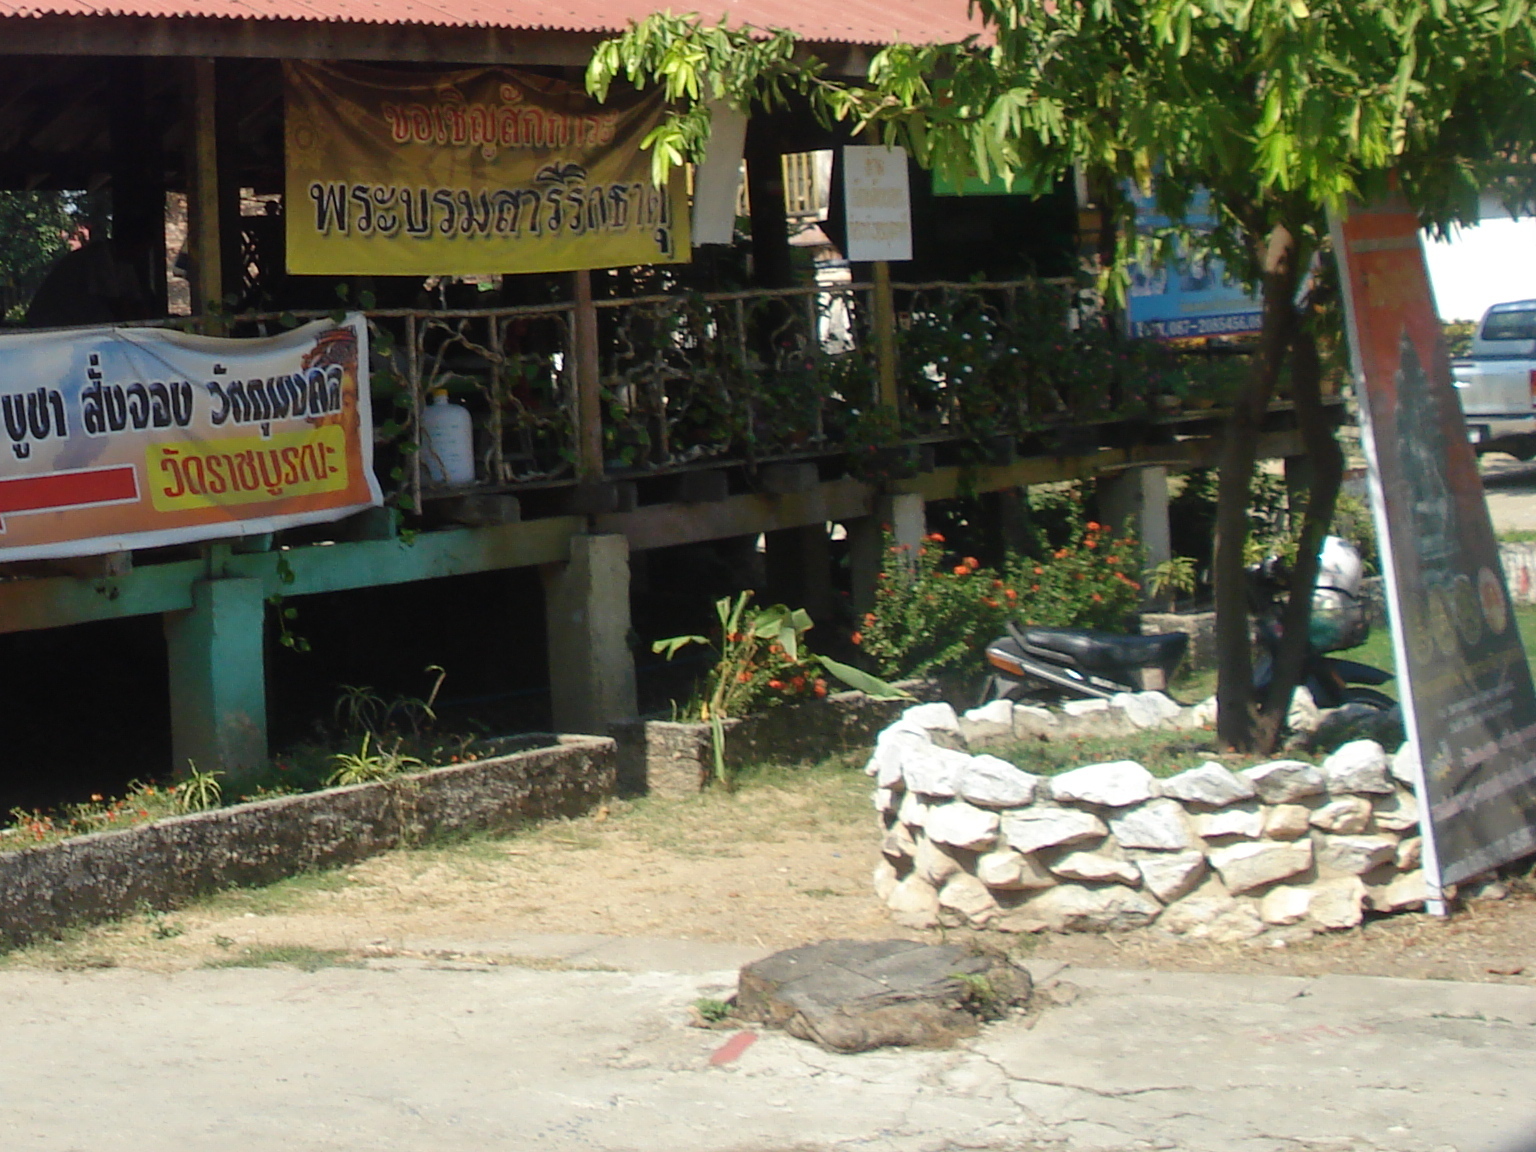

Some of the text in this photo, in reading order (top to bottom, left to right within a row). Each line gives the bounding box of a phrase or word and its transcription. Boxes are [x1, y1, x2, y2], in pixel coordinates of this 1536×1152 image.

[383, 82, 618, 159] ขอเชิญสักการะ
[310, 160, 676, 257] พระบรมสารีริกธาตุ
[3, 386, 68, 460] บูชา
[81, 353, 194, 434] สั่งจอง
[209, 364, 344, 440] วัตถุมงคล
[160, 446, 337, 498] วัดราชบูรณะ
